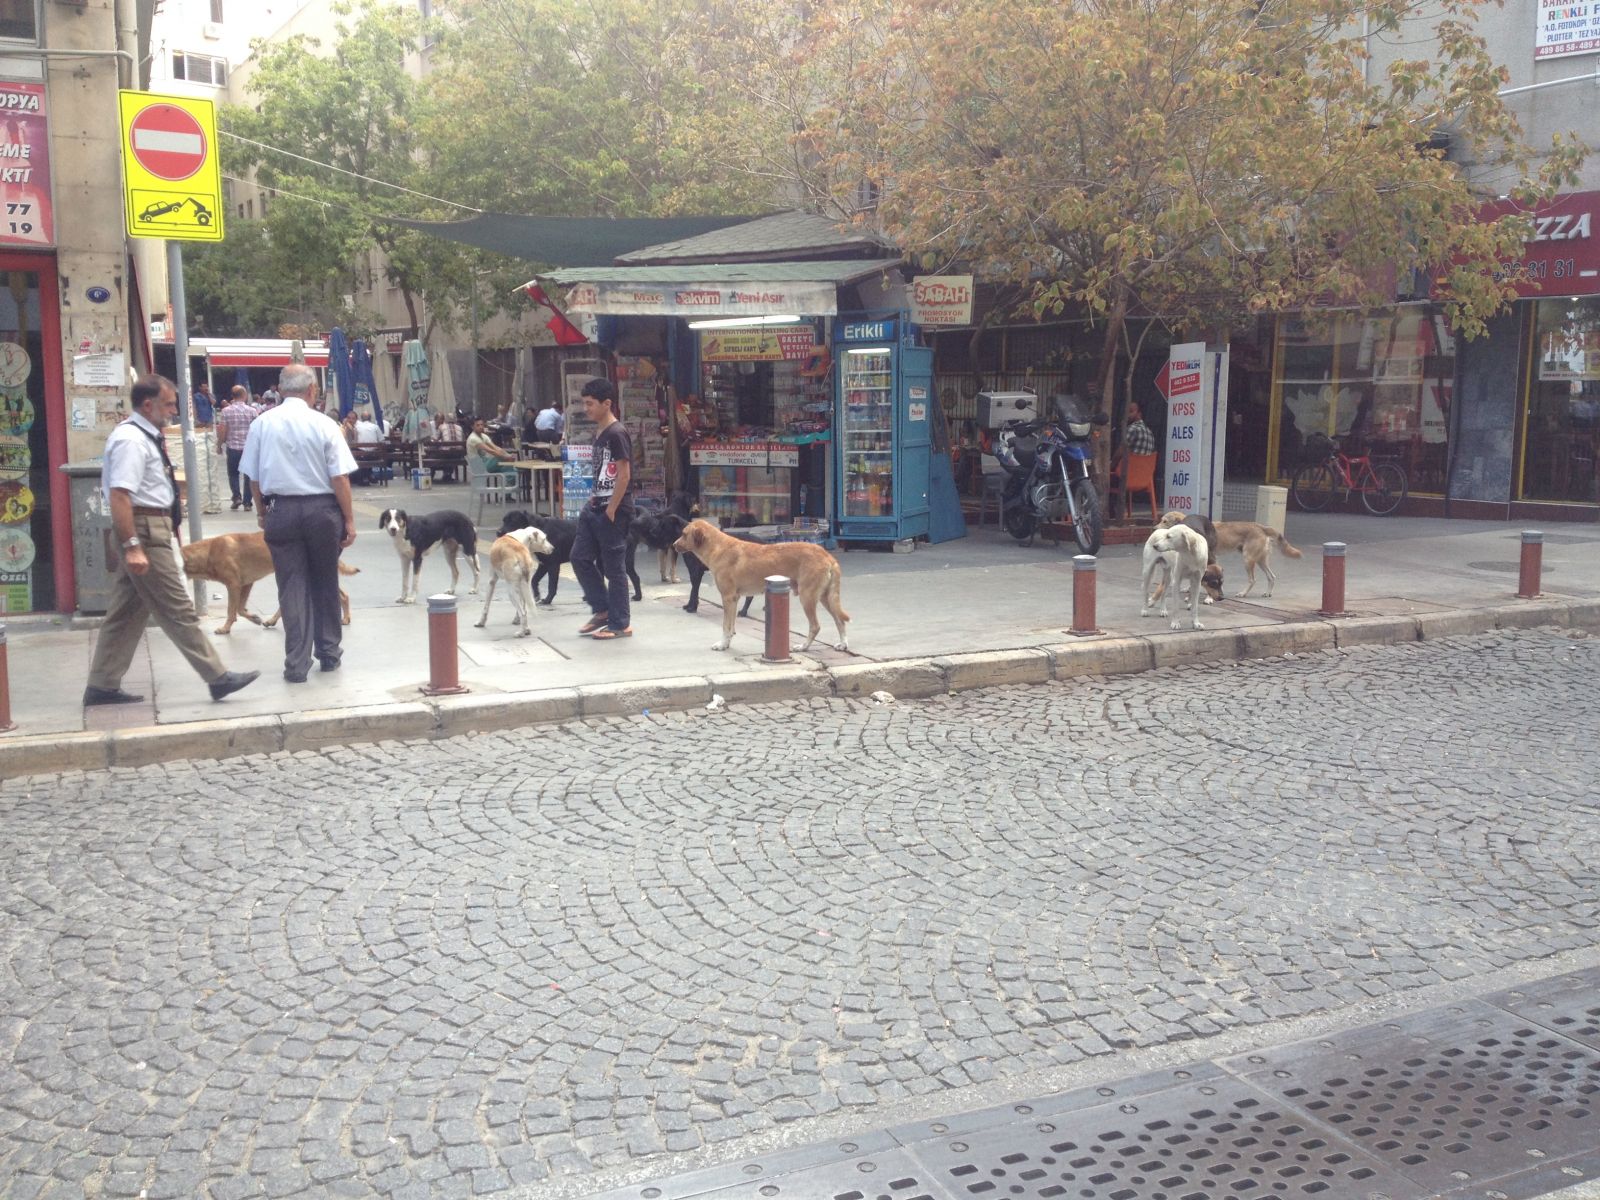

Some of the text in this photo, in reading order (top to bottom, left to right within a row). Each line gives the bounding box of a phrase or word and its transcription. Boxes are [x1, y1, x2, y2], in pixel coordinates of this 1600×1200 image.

[1547, 32, 1573, 42] PLOTTER
[6, 203, 31, 215] 77
[9, 222, 33, 233] 19
[1554, 258, 1574, 278] 31
[916, 286, 967, 303] SABAH
[844, 323, 883, 340] Erikli
[1172, 402, 1196, 416] KPSS
[1171, 426, 1194, 440] ALES
[1173, 449, 1191, 463] DGS
[1172, 470, 1190, 486] AÖF
[1168, 496, 1192, 509] KPDS
